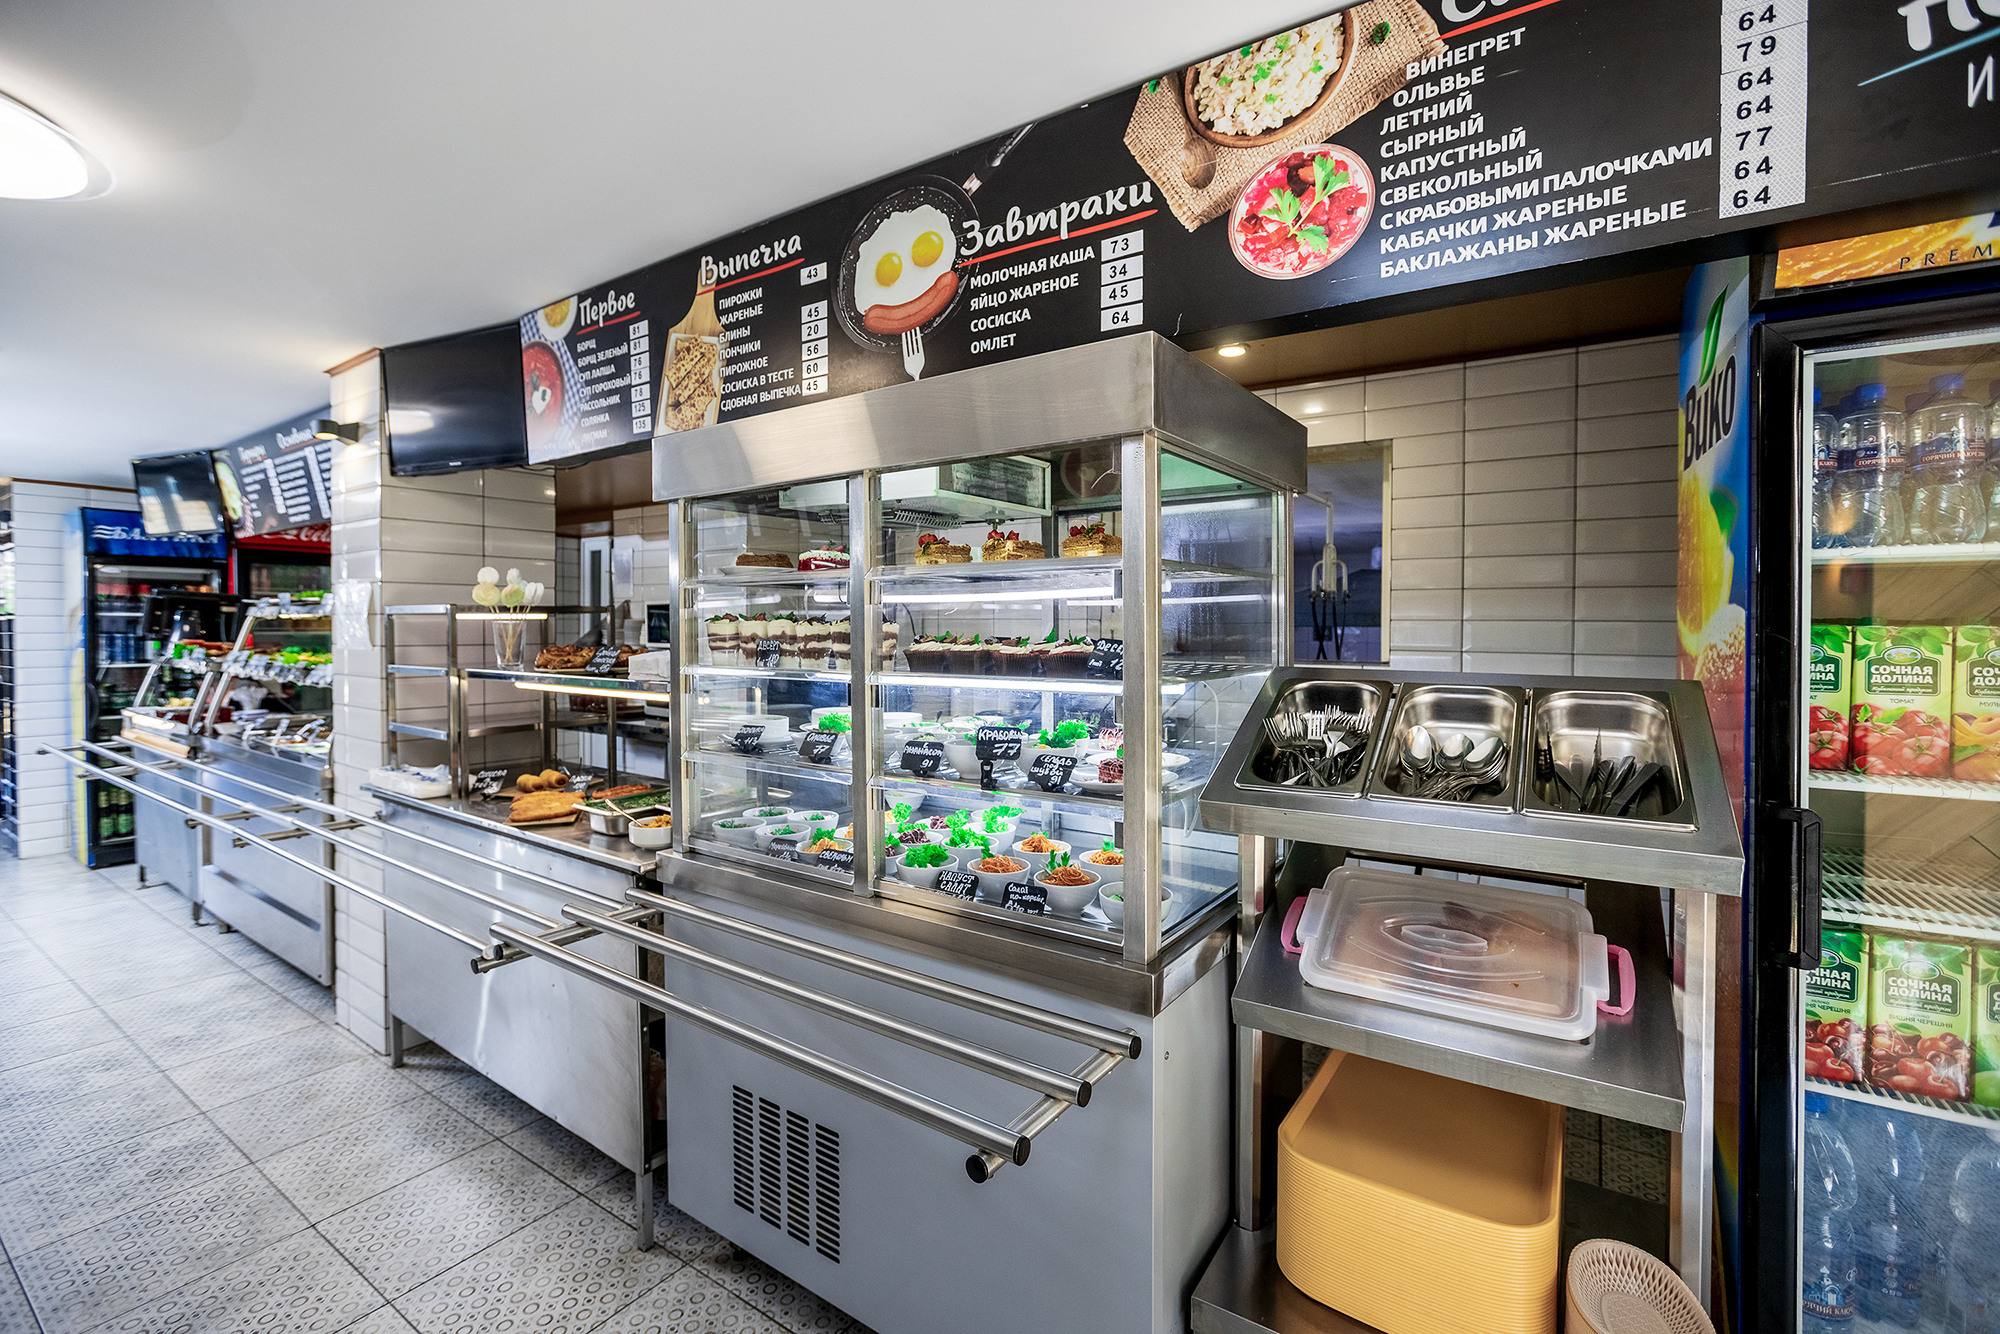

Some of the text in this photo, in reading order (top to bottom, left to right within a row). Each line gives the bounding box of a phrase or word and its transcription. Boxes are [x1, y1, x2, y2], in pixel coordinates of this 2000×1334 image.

[1738, 4, 1777, 31] 64
[1406, 27, 1526, 80] ВИНЕГРЕТ
[1737, 35, 1777, 62] 79
[1392, 65, 1485, 108] ОЛЬВЬЕ
[1737, 66, 1774, 91] 64
[1379, 90, 1473, 136] ЛЕТНИЙ
[1736, 95, 1773, 120] 64
[1380, 112, 1485, 159] СЫРНЫЙ
[1735, 125, 1773, 151] 77
[1380, 126, 1526, 183] КАПУСТНЫЙ
[1380, 147, 1543, 206] СВЕКОЛЬНЫЙ
[1734, 155, 1773, 180] 64
[1380, 137, 1713, 230] С КРАБОВЫМИ ПАЛОЧКАМИ
[1732, 185, 1771, 209] 64
[960, 181, 1153, 256] Завтраки
[1380, 184, 1628, 254] КАБАЧКИ ЖАРЕНЫЕ
[1110, 238, 1129, 254] 73
[1380, 199, 1687, 278] БАКЛАЖАНЫ ЖАРЕНЫЕ
[701, 235, 802, 286] Выпечка
[970, 245, 1095, 290] МОЛОЧНАЯ КАША
[1109, 263, 1128, 279] 34
[806, 267, 818, 280] 43
[719, 287, 763, 310] ПИРОЖКИ
[970, 273, 1079, 311] ЯЙЦО ЖАРЕНОЕ
[1109, 284, 1129, 301] 45
[579, 289, 636, 327] Первое
[719, 304, 764, 326] ЖАРЕНЫЕ
[807, 306, 820, 319] 45
[1111, 310, 1130, 325] 64
[632, 325, 641, 336] 81
[807, 324, 819, 337] 20
[970, 307, 1031, 332] СОСИСКА
[577, 338, 597, 353] БОРЩ
[719, 326, 751, 343] БЛИНЫ
[970, 333, 1017, 354] ОМЛЕТ
[577, 342, 628, 368] БОРЩ ЗЕЛЕНЫЙ
[633, 341, 641, 351] 81
[719, 340, 761, 360] ПОНЧИКИ
[807, 344, 819, 356] 56
[578, 364, 616, 383] СУП ЛАПША
[634, 357, 643, 368] 76
[719, 356, 768, 378] ПИРОЖНОЕ
[806, 362, 819, 375] 60
[579, 373, 632, 398] СУП ГОРОХОВЫЙ
[634, 370, 643, 381] 76
[720, 368, 795, 394] СОСИСКА В ТЕСТЕ
[806, 380, 819, 391] 45
[634, 387, 643, 398] 78
[720, 384, 801, 412] СДОБНАЯ ВЫПЕЧКА
[634, 401, 646, 413] 125
[635, 419, 646, 430] 135
[1870, 665, 1933, 675] СОЧНАЯ
[1870, 674, 1933, 683] ДОЛИНА
[992, 742, 1022, 756] 77
[1887, 986, 1953, 1004] ДОЛИНА
[1888, 976, 1953, 994] СОЧНАЯ
